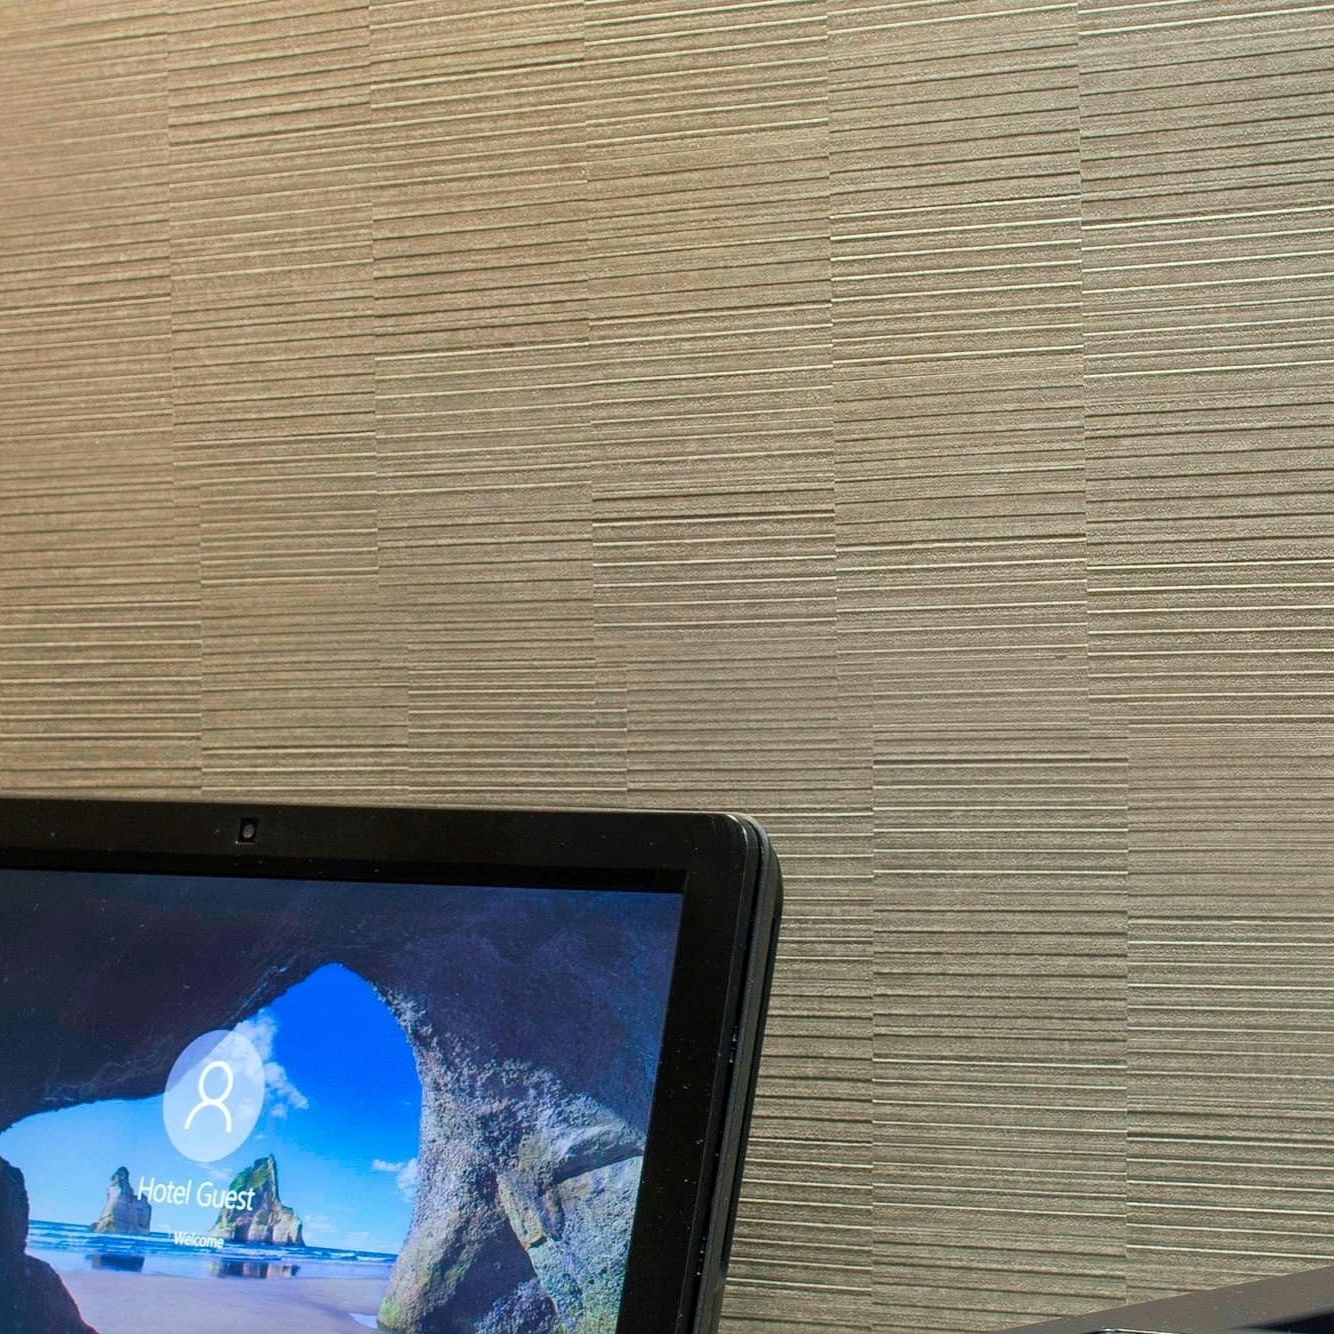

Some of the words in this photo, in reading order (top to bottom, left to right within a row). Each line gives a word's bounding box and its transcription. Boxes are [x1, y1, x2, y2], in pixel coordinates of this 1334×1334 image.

[137, 1175, 193, 1205] Hotel
[196, 1180, 256, 1211] Guest
[173, 1230, 225, 1249] Welcome
